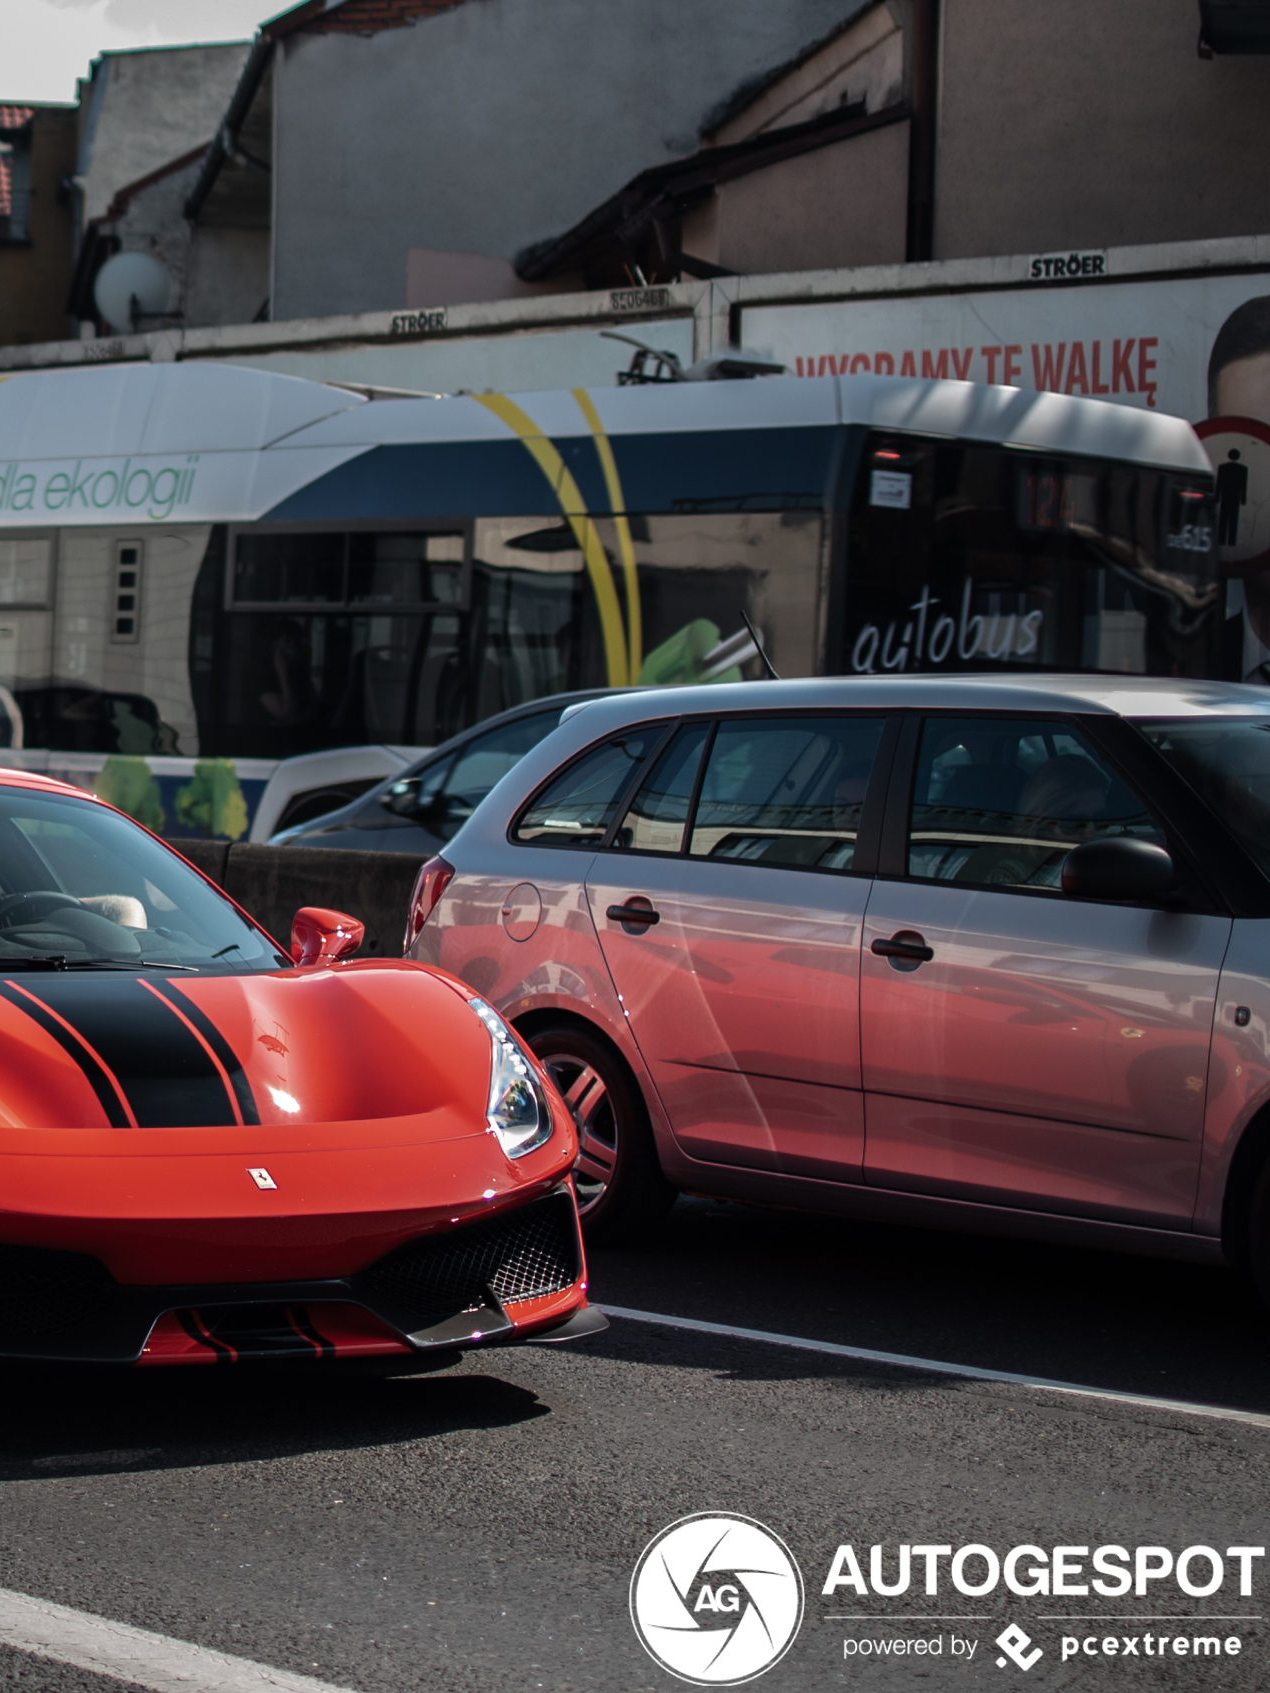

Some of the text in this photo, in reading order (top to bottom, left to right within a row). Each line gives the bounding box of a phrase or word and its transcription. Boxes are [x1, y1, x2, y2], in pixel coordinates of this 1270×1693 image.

[1031, 253, 1104, 277] STRÖER
[392, 310, 444, 331] STRÖER
[981, 344, 1023, 386] TE
[1032, 338, 1159, 408] WALKĘ
[43, 455, 200, 520] ekologii
[851, 576, 1043, 674] autobus
